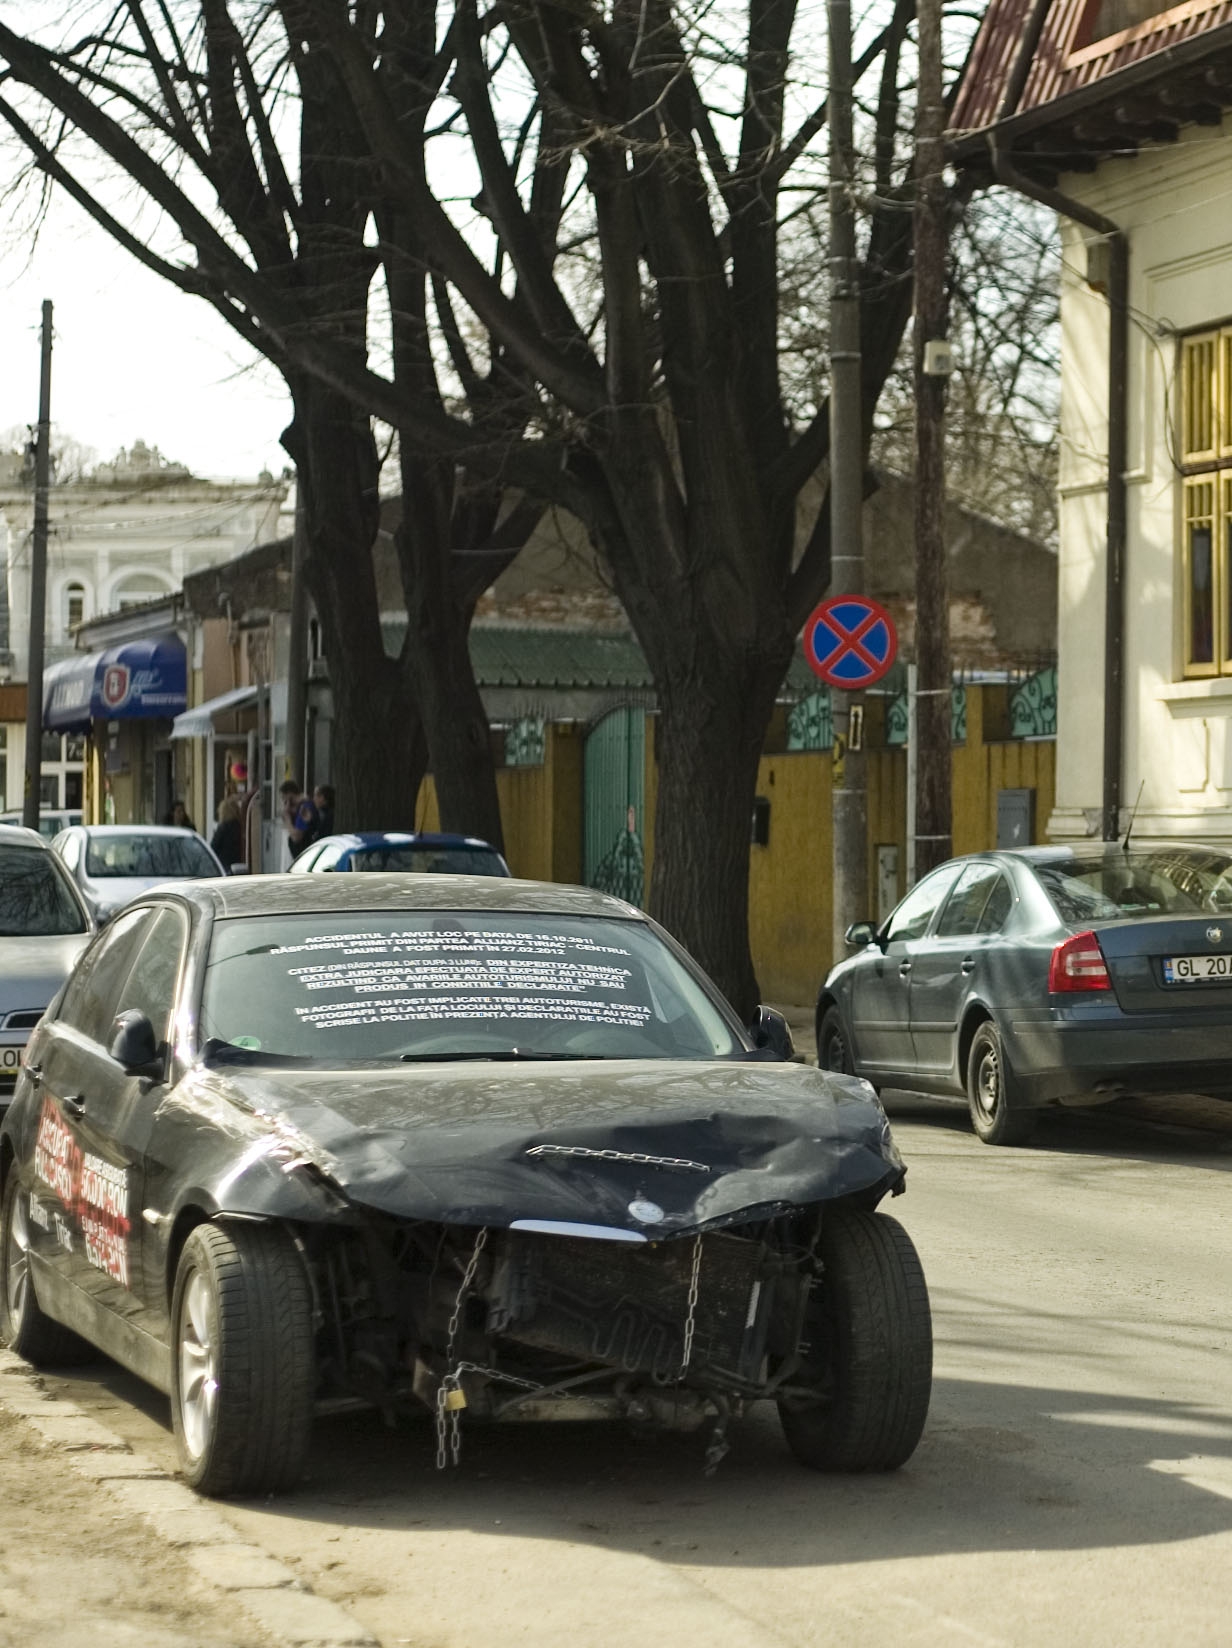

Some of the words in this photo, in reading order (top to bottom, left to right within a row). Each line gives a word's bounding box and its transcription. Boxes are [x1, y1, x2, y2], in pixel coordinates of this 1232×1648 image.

[305, 932, 385, 944] ACCIDENTUL
[343, 946, 387, 955] DAUNE
[350, 939, 393, 947] PRIMIT
[474, 938, 525, 946] ALLIANZ
[577, 944, 631, 956] CENTRUL
[288, 965, 326, 975] CITEZ
[510, 960, 576, 970] EXPERTIZA
[578, 963, 632, 976] TEHNICA
[299, 972, 344, 983] EXTRA
[345, 967, 412, 978] JUDICIARA
[415, 966, 488, 974] EFECTUATA
[510, 967, 555, 975] EXPERT
[559, 969, 625, 982] AUTORIZAT
[1177, 959, 1199, 977] GL
[354, 983, 408, 993] PRODUS
[406, 974, 462, 982] AVARIILE
[464, 974, 574, 984] AUTOTURISMULUI
[599, 981, 625, 989] SAU
[312, 1001, 374, 1013] ACCIDENT
[394, 997, 428, 1005] FOST
[301, 1008, 375, 1023] FOTOGRAFII
[398, 1005, 414, 1013] LA
[603, 1009, 619, 1017] AU
[621, 1011, 650, 1021] FOST
[316, 1016, 362, 1029] SCRISE
[363, 1015, 380, 1024] LA
[510, 1012, 576, 1021] AGENTULUI
